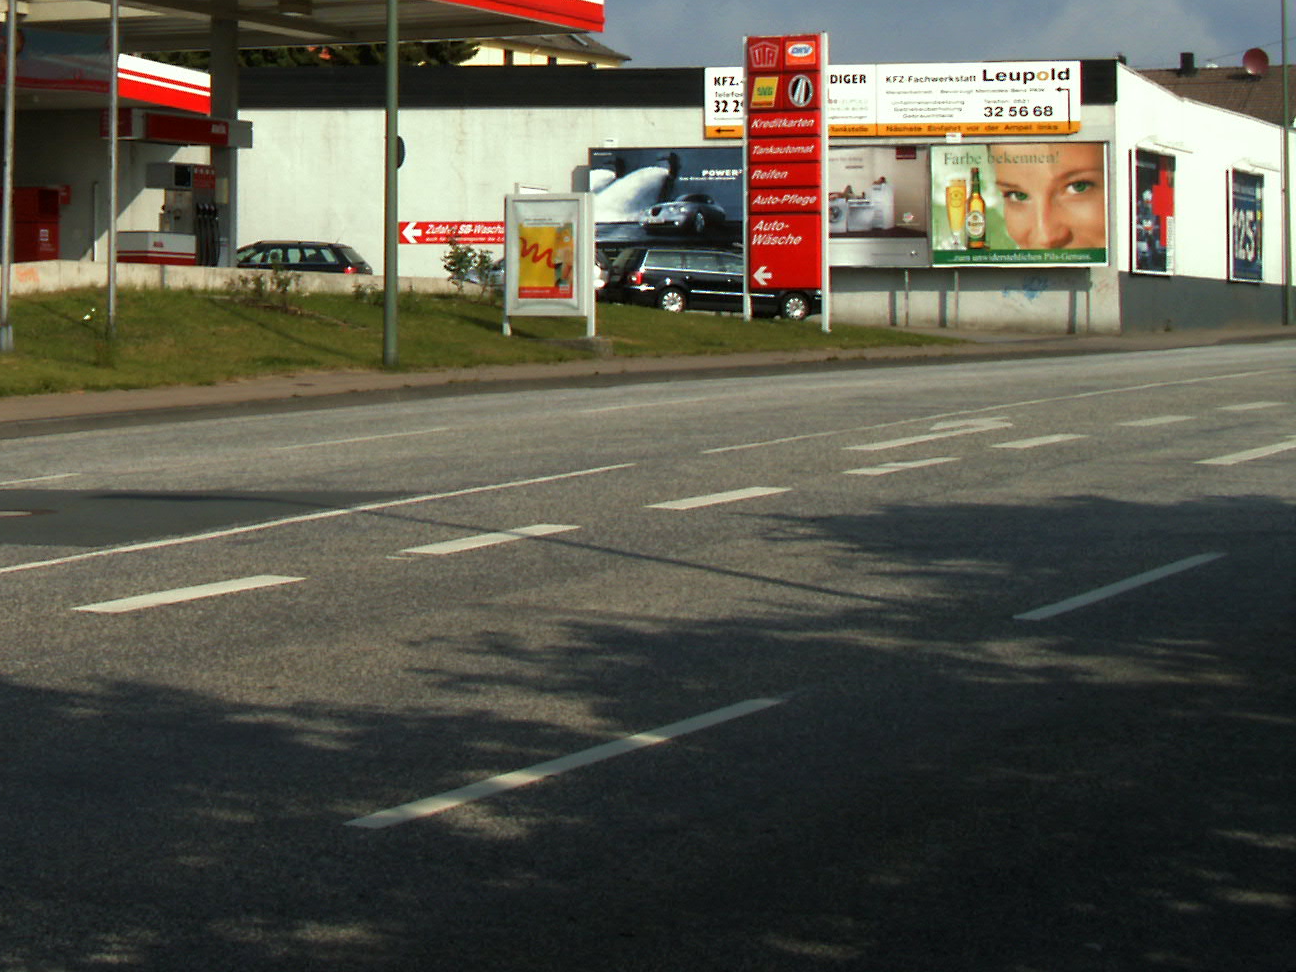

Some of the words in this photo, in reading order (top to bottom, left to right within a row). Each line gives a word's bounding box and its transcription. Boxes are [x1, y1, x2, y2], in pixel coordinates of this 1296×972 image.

[830, 74, 866, 84] DIGER
[982, 67, 1070, 84] Leupold
[714, 100, 729, 113] 32
[983, 106, 1004, 117] 32
[1009, 106, 1029, 117] 56
[1033, 105, 1053, 117] 68
[751, 118, 815, 128] Kreditkarten
[944, 152, 982, 165] Farbe
[751, 169, 788, 180] Reifen
[752, 194, 817, 206] Auto-Pflege
[753, 219, 789, 231] Auto-
[751, 233, 802, 245] Wäsche
